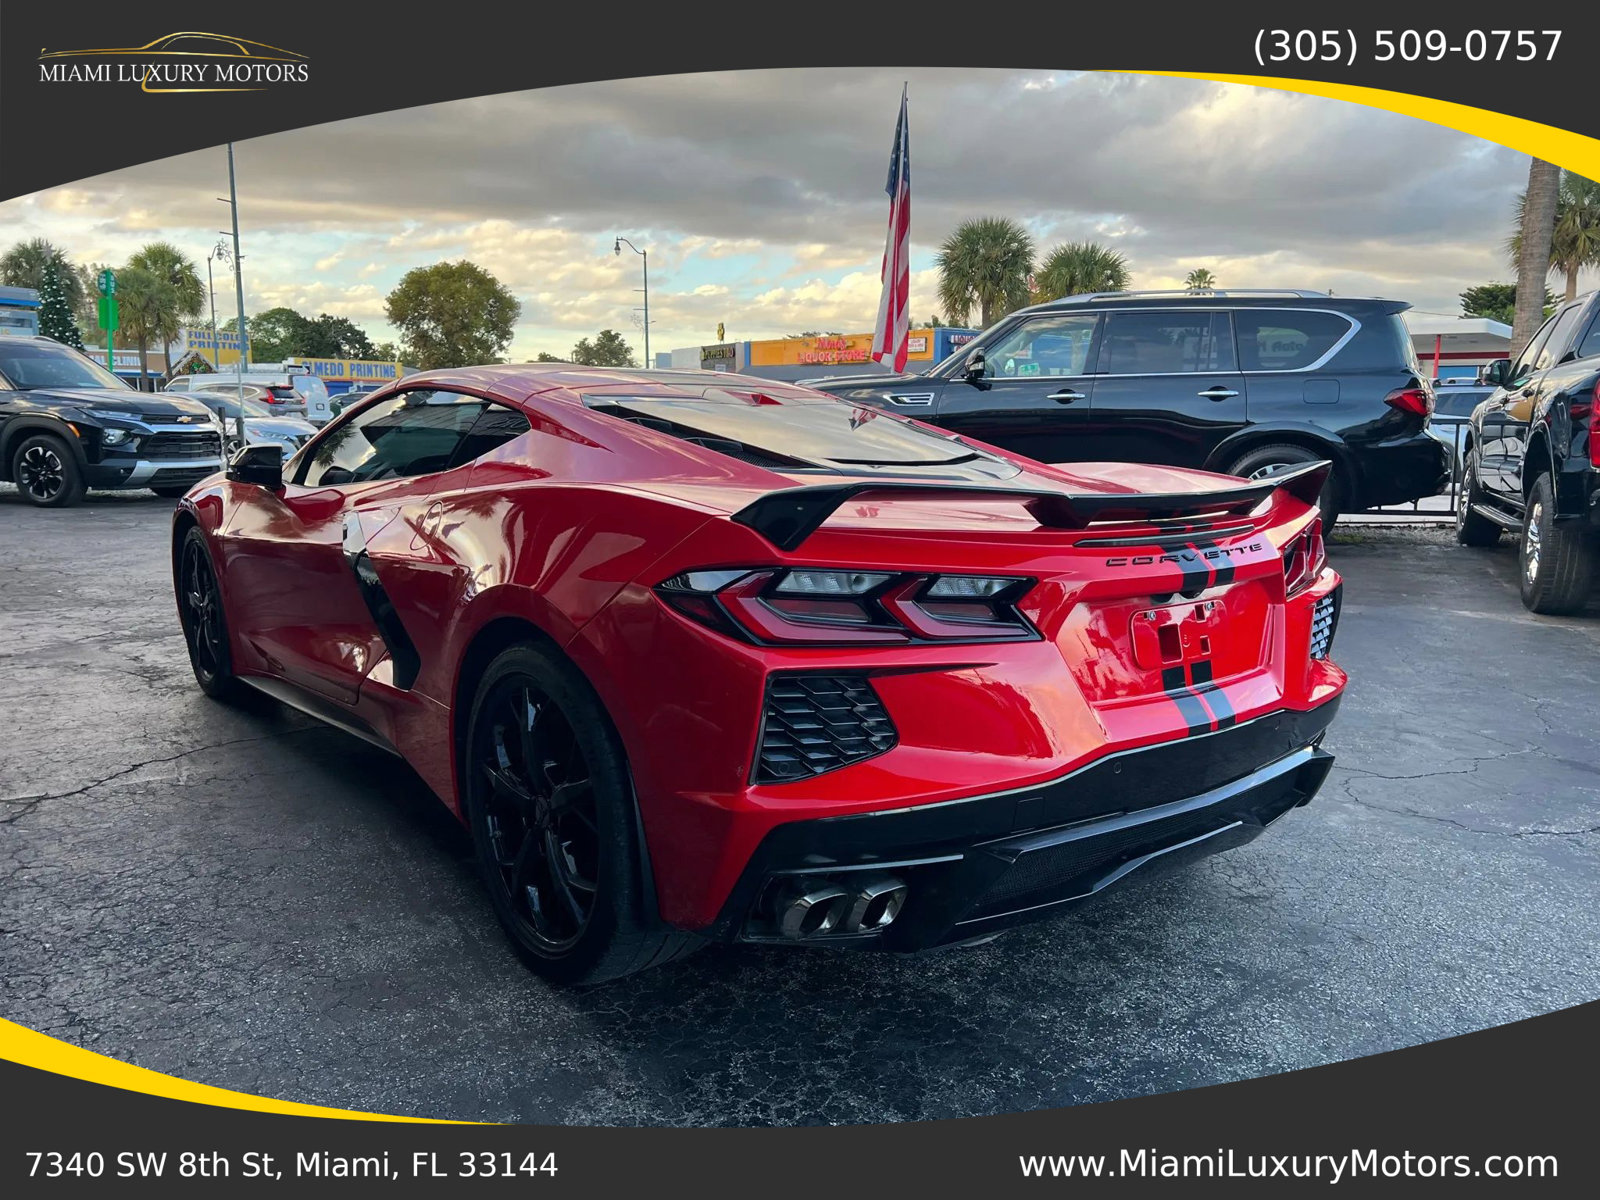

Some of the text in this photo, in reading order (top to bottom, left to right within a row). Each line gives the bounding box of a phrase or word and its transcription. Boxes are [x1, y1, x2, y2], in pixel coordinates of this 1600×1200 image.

[188, 330, 212, 340] FULL
[349, 362, 396, 378] PRINTING
[1105, 543, 1263, 567] CORVETTE
